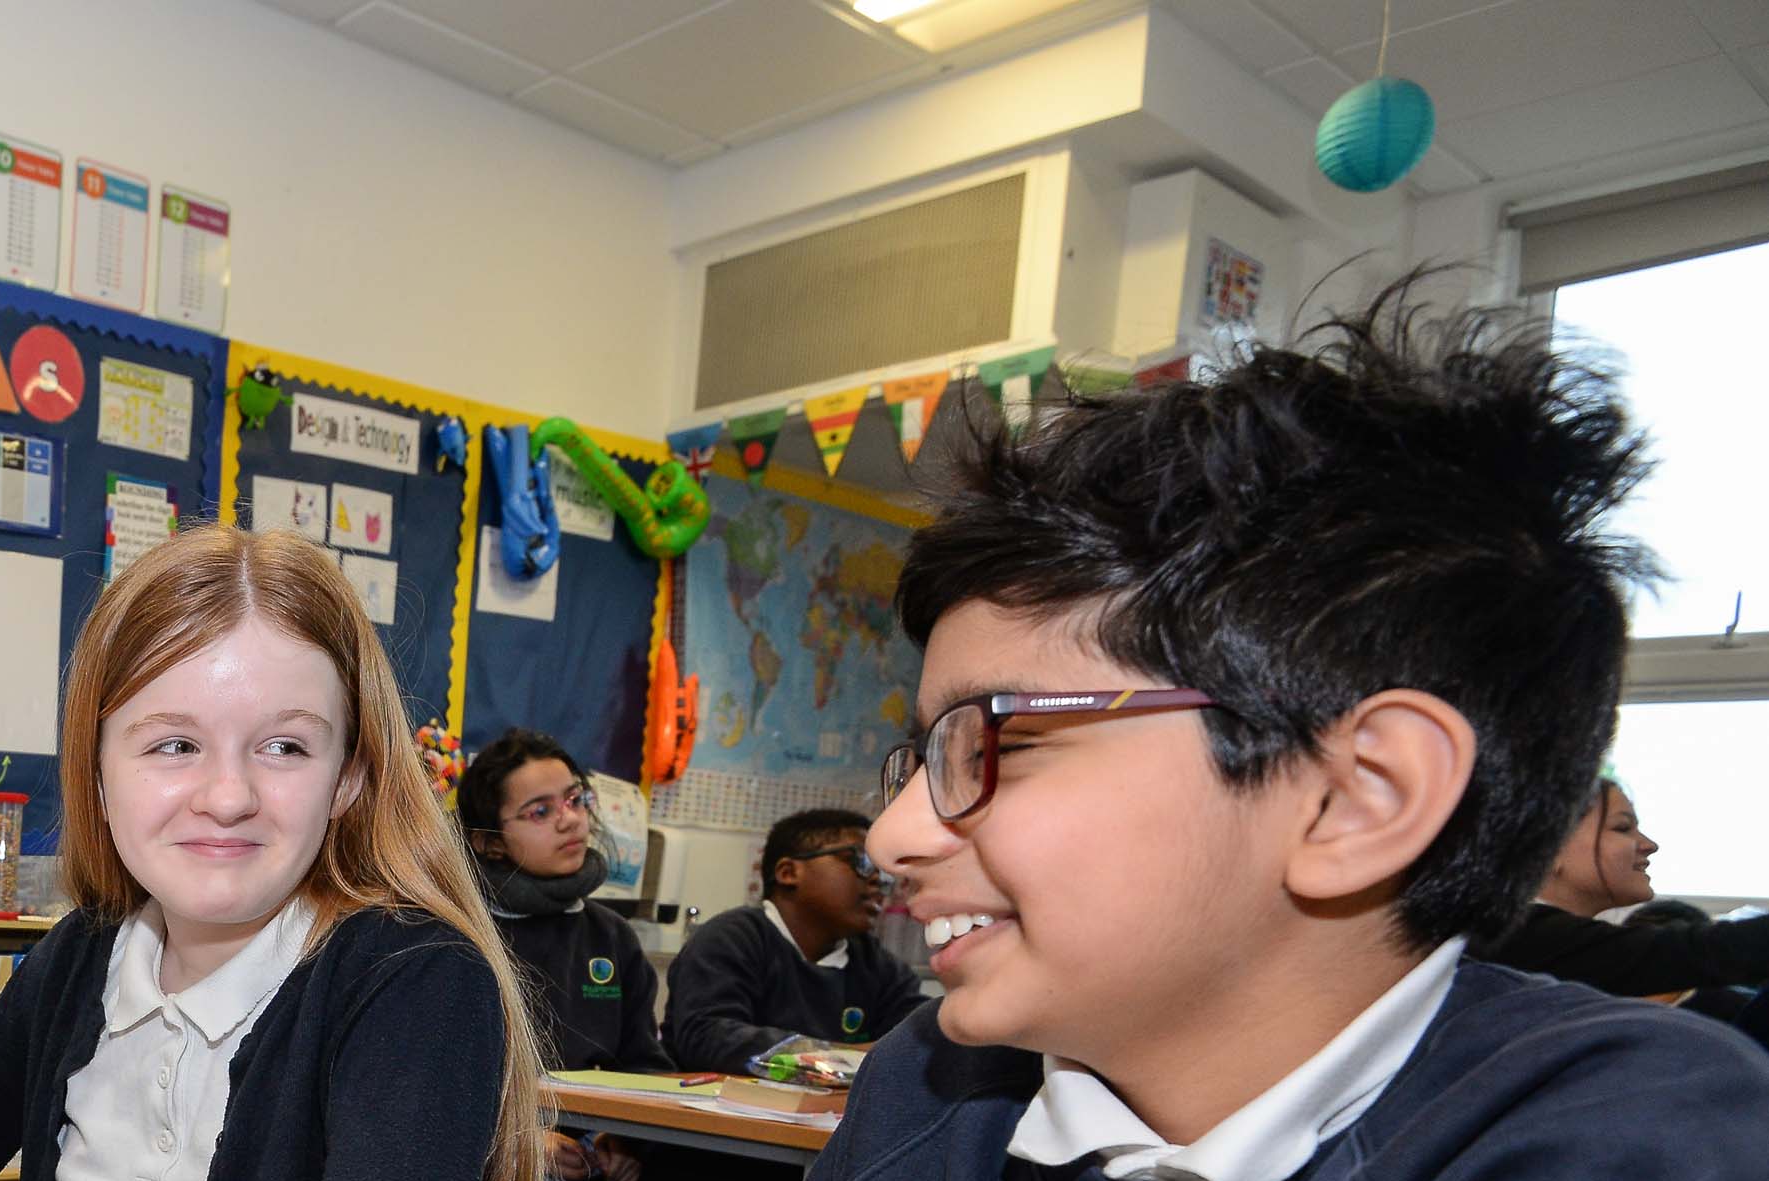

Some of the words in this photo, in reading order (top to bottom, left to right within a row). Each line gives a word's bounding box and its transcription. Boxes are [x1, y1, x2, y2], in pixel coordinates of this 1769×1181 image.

[87, 175, 101, 194] 11
[169, 200, 185, 218] 12
[297, 405, 338, 447] Design
[354, 416, 411, 465] Technology
